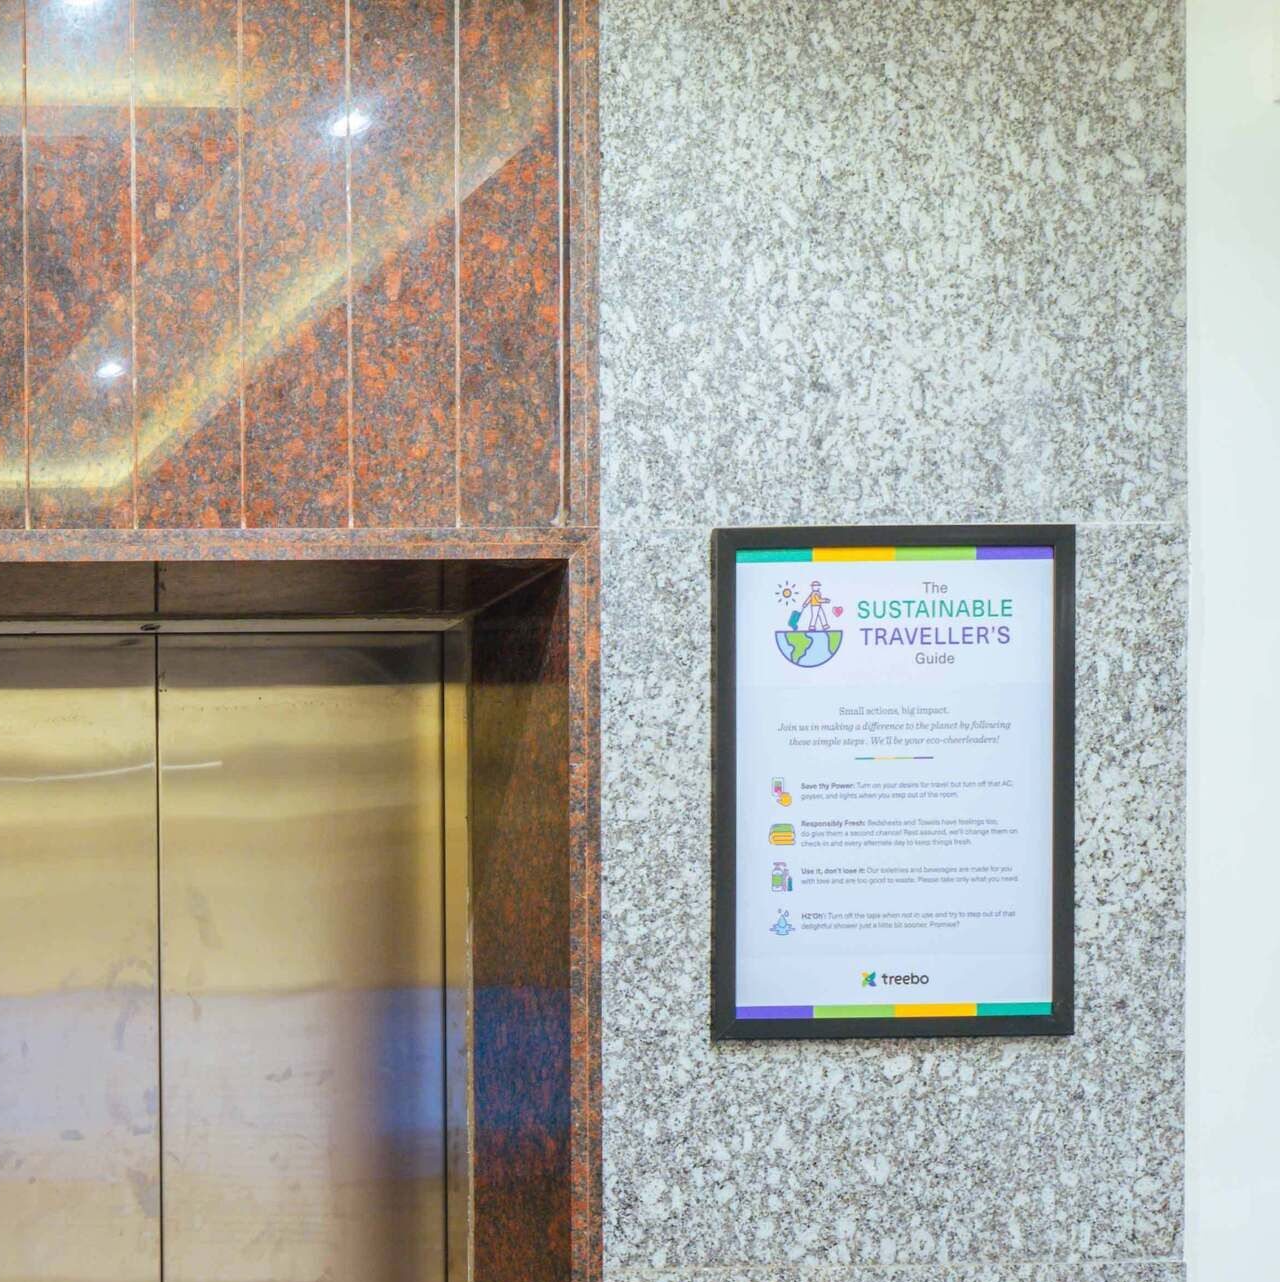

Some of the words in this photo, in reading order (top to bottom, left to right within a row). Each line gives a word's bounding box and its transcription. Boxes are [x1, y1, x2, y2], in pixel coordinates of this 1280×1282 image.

[922, 581, 948, 594] The
[857, 598, 1013, 619] SUSTAINABLE
[860, 626, 1010, 646] TRAVELLER'S
[915, 652, 955, 665] Guide
[839, 707, 865, 716] Small
[866, 706, 900, 718] actions,
[901, 706, 915, 718] big
[916, 705, 949, 718] impact.
[777, 723, 797, 731] Join
[811, 722, 820, 731] in
[821, 722, 854, 734] making
[862, 722, 903, 731] difference
[905, 722, 914, 730] to
[915, 721, 929, 730] the
[930, 721, 958, 733] planet
[959, 721, 969, 733] by
[970, 721, 1011, 733] following
[788, 737, 811, 746] these
[813, 737, 842, 749] simple
[893, 736, 903, 745] be
[904, 738, 925, 748] your
[926, 735, 1000, 745] eco-cheerleaders!
[882, 972, 929, 985] treebo
